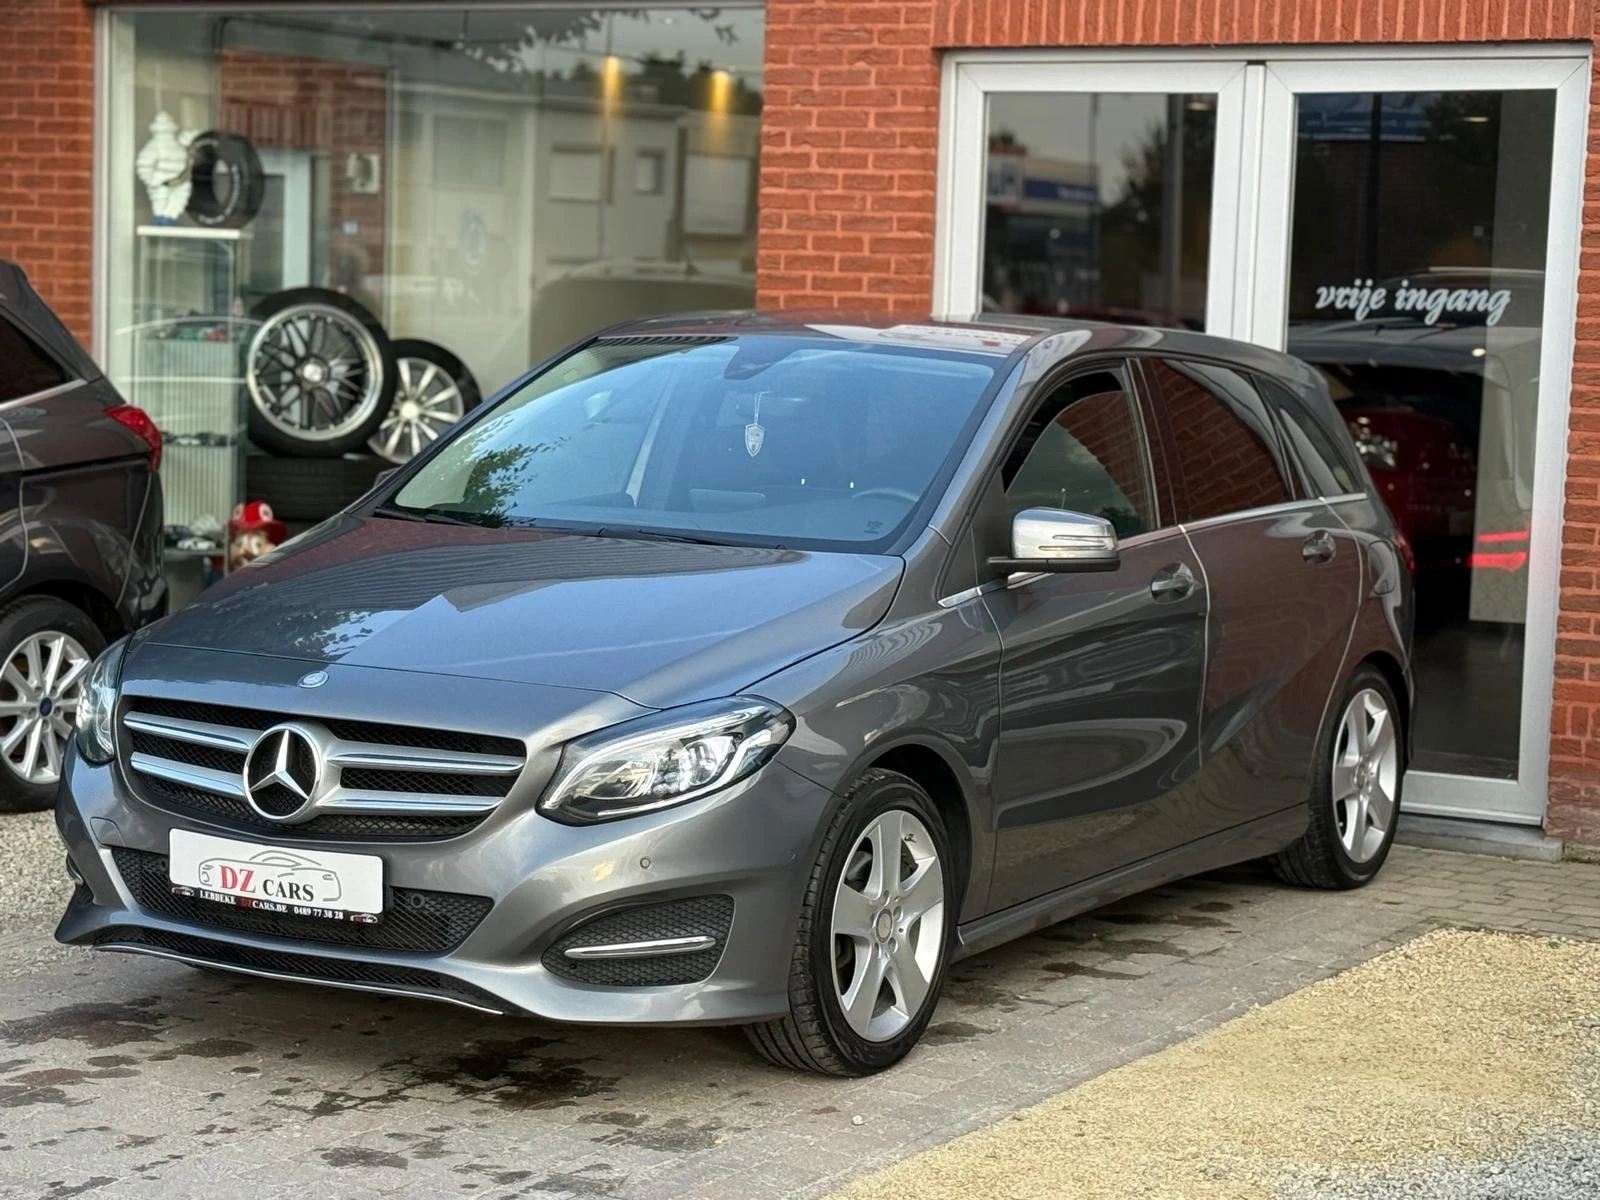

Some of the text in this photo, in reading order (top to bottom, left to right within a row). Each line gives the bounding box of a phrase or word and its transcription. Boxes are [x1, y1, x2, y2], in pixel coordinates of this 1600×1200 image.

[1315, 278, 1511, 326] vrije ingang
[219, 864, 314, 902] DZ CARS
[313, 907, 322, 917] 77
[323, 909, 333, 919] 38
